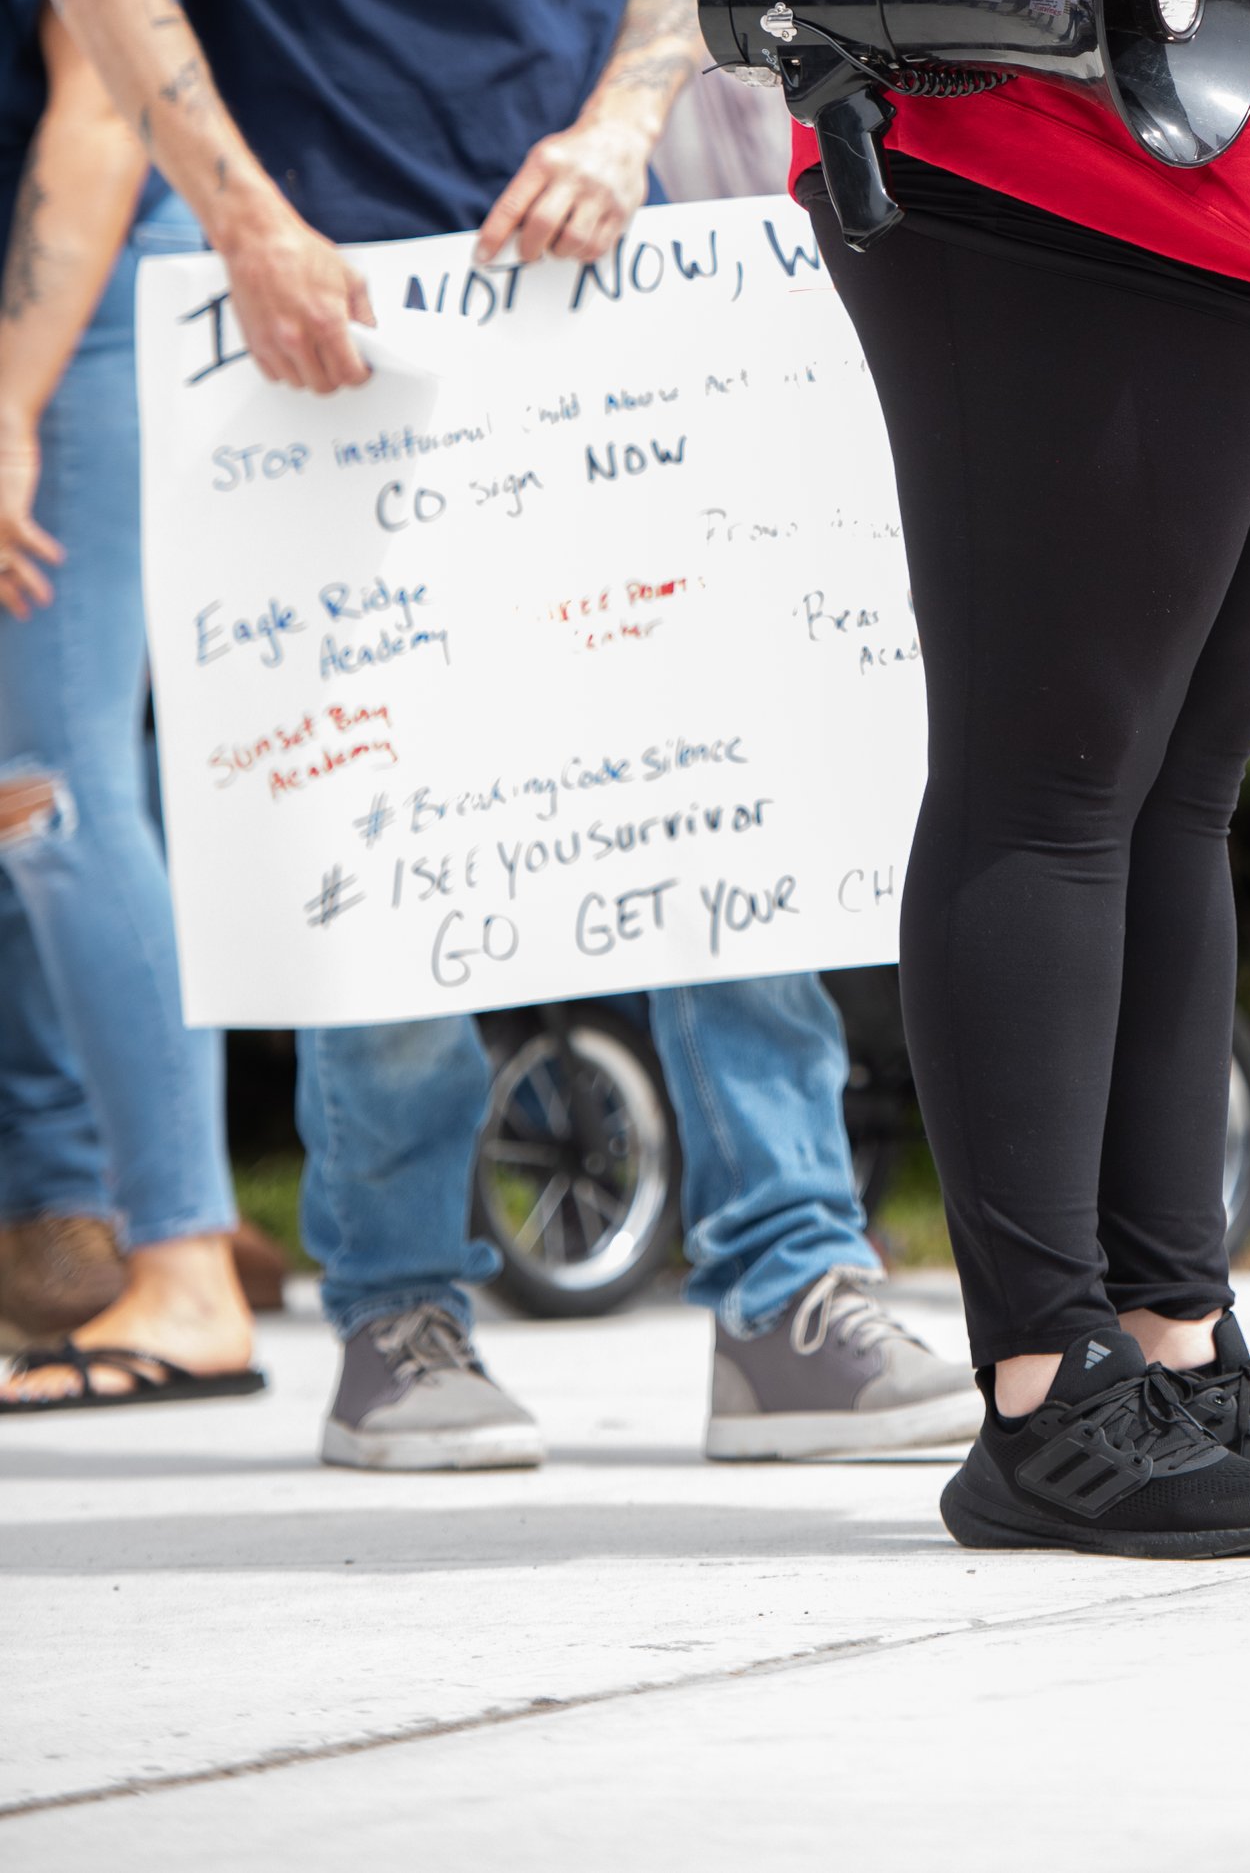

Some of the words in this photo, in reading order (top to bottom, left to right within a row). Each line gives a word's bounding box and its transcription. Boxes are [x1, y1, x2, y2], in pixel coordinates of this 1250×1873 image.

[211, 440, 313, 493] STOP
[584, 434, 688, 485] NOW
[193, 597, 310, 670] Eagle
[318, 573, 433, 633] Ridge
[318, 628, 452, 682] Academy
[205, 710, 315, 790] Sunset
[323, 701, 394, 734] Bay
[268, 738, 399, 805] Academy
[431, 909, 520, 988] GO
[574, 877, 680, 957] GET
[700, 874, 800, 958] YOUR
